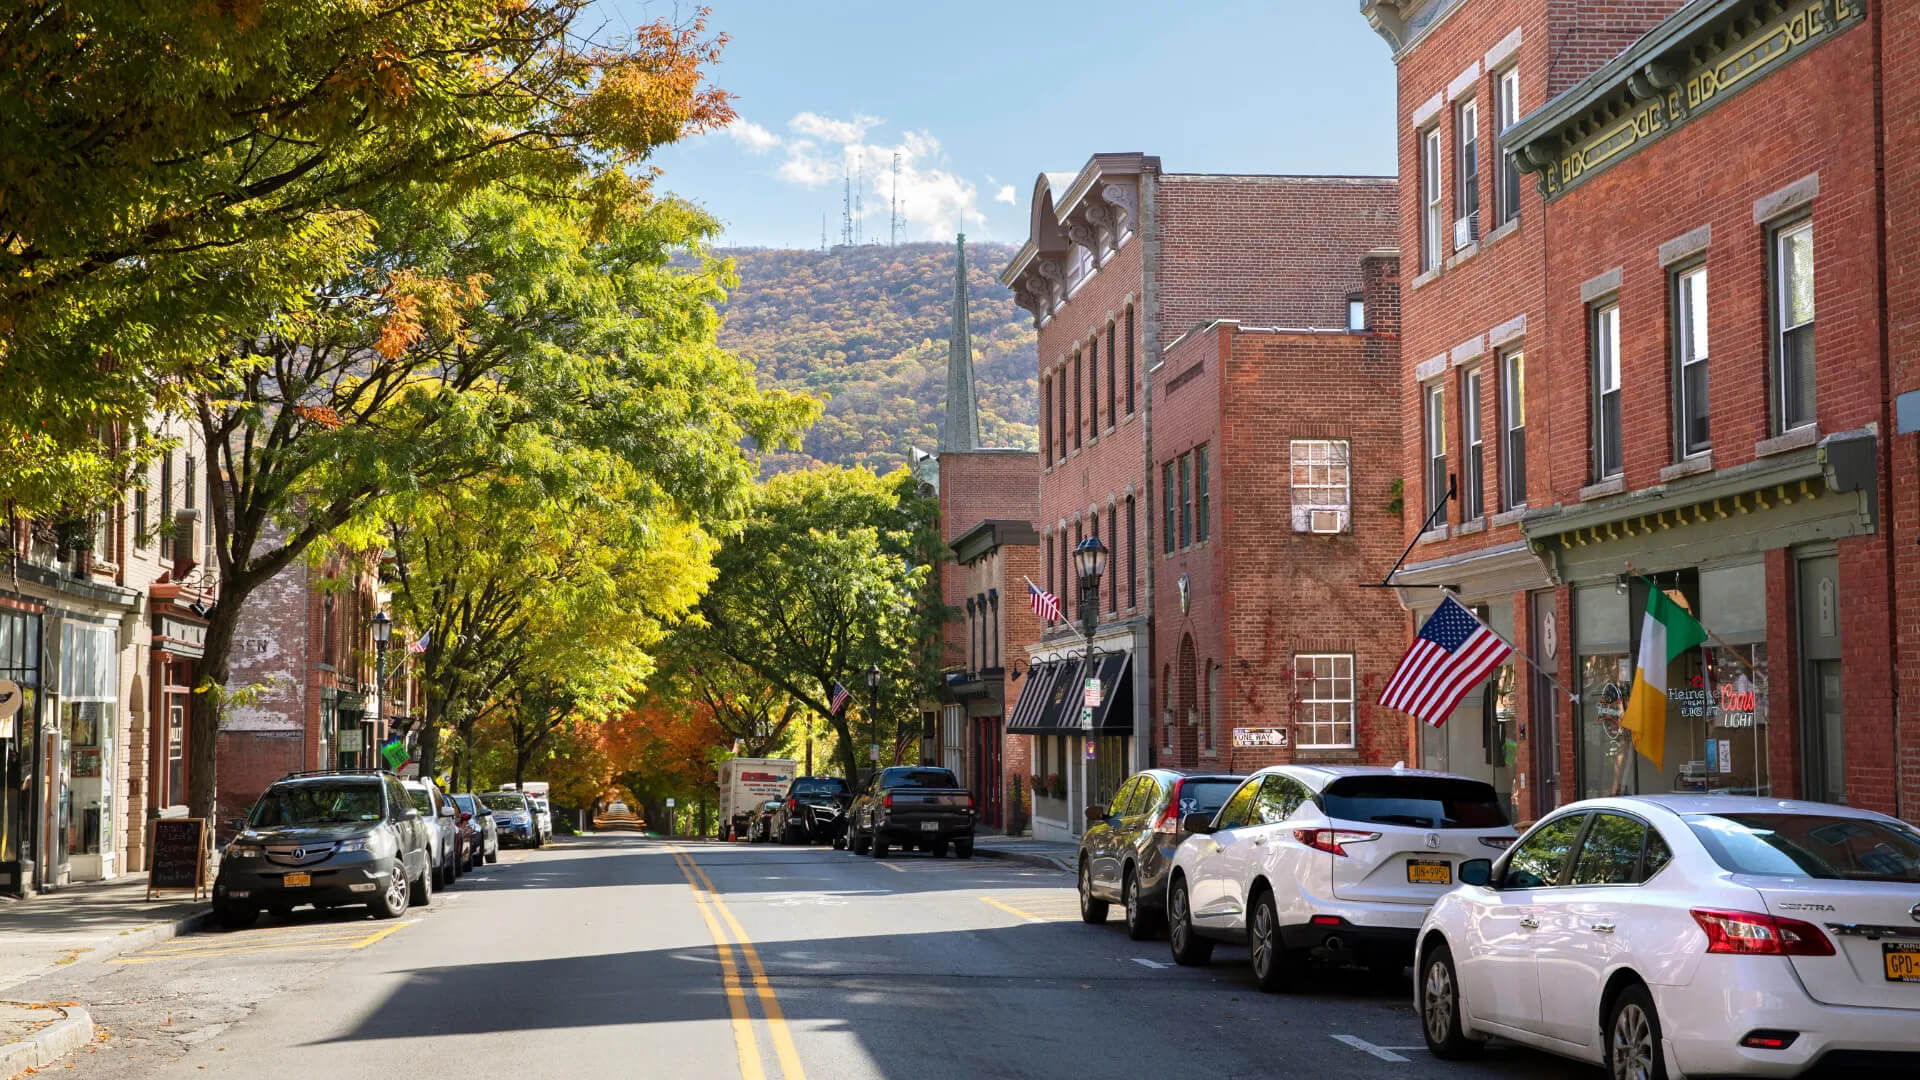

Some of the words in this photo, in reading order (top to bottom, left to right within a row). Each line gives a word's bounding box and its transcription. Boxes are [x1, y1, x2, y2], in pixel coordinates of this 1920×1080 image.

[1720, 682, 1755, 712] Coors
[1724, 712, 1754, 728] LIGHT
[1239, 733, 1255, 741] ONE
[1256, 733, 1271, 741] WAY
